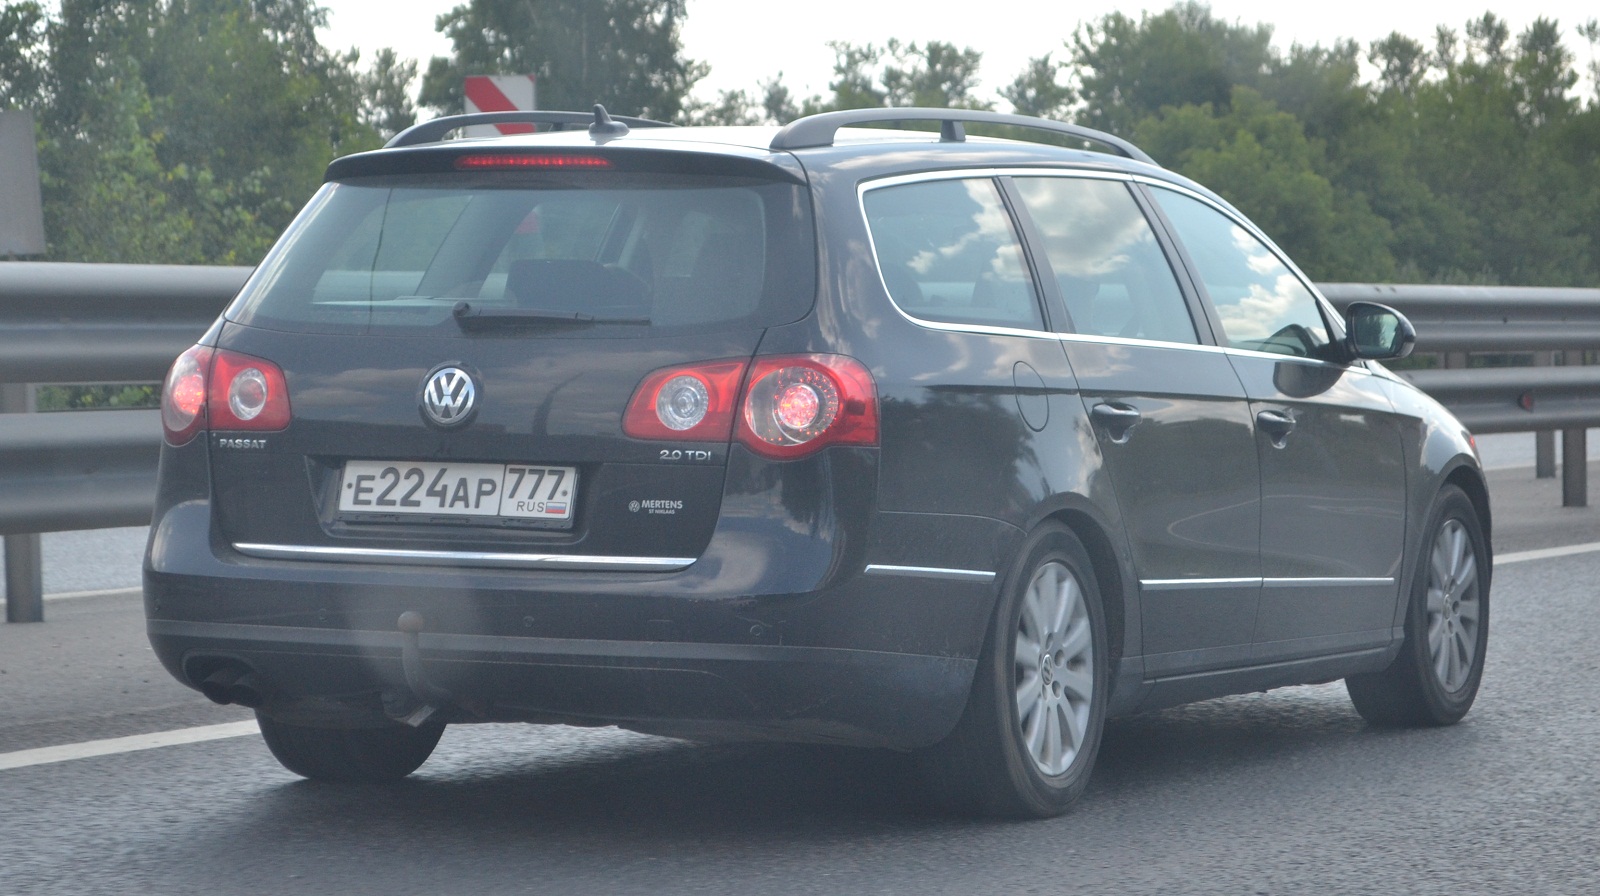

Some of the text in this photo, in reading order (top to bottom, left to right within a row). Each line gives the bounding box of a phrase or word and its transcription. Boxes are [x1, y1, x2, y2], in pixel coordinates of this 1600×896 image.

[220, 438, 266, 449] PASSAT
[685, 450, 711, 460] TDI
[352, 467, 565, 509] E224AP 777
[516, 501, 545, 512] RUS
[641, 500, 683, 509] MERTENS
